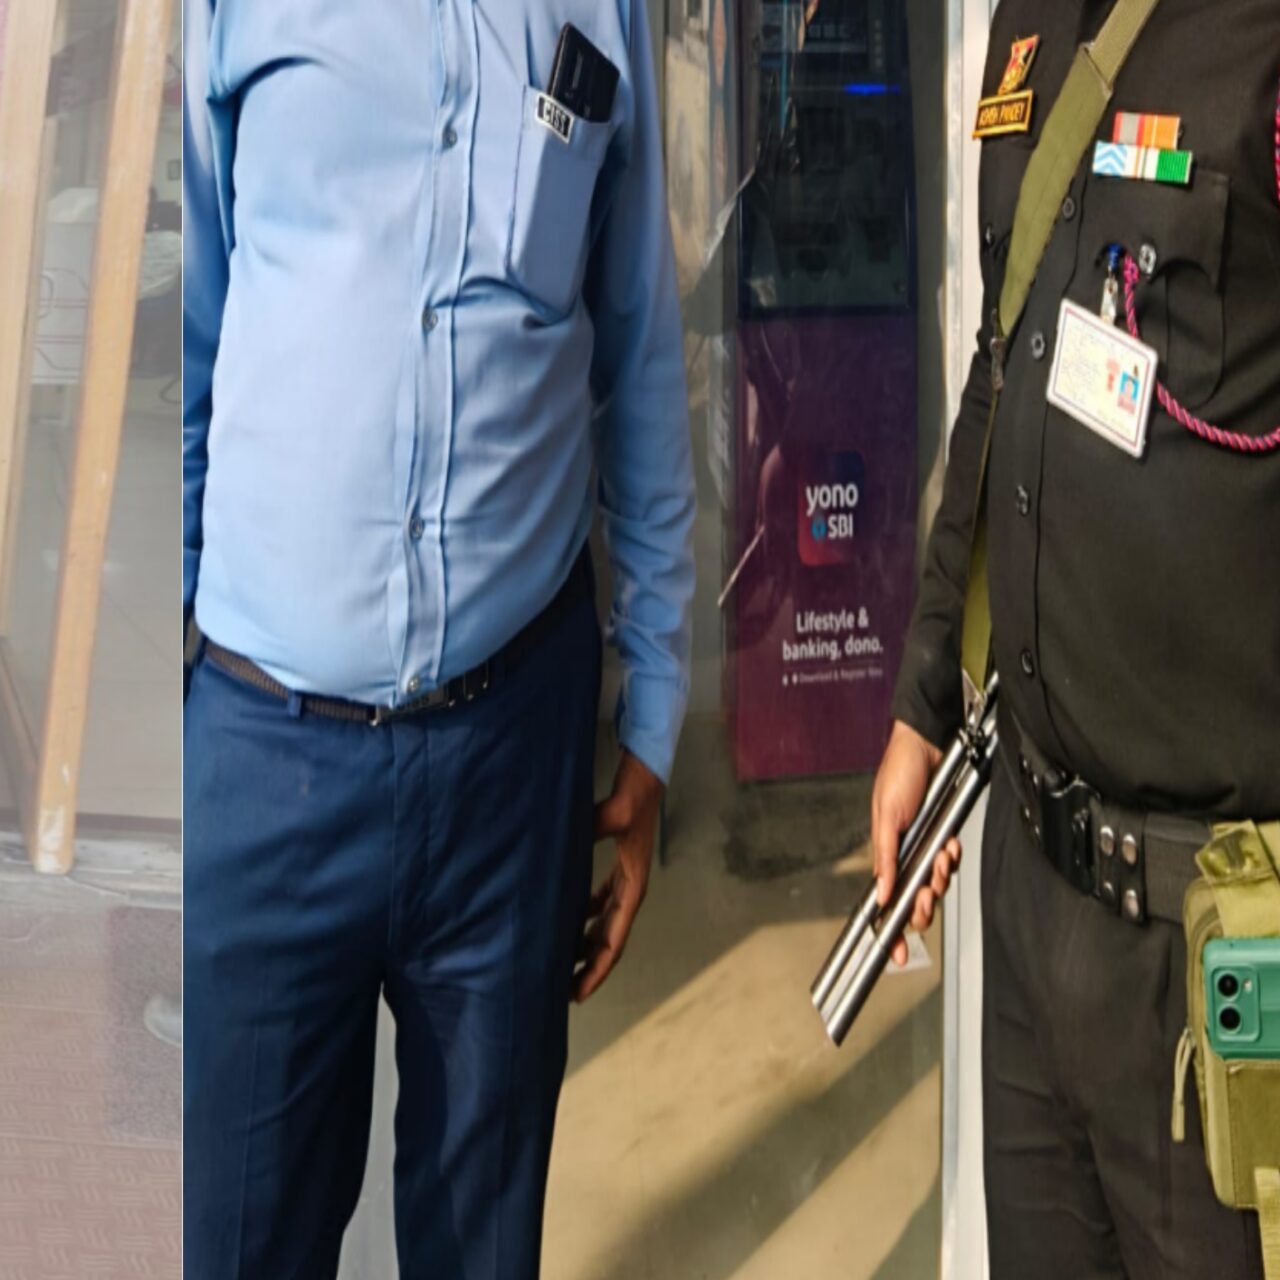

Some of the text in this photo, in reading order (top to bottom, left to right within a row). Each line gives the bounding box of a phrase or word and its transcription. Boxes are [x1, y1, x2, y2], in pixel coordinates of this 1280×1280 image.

[806, 483, 858, 516] yono
[827, 513, 854, 539] SBI
[796, 607, 869, 634] Lifestyle &
[782, 634, 884, 662] banking, dono.
